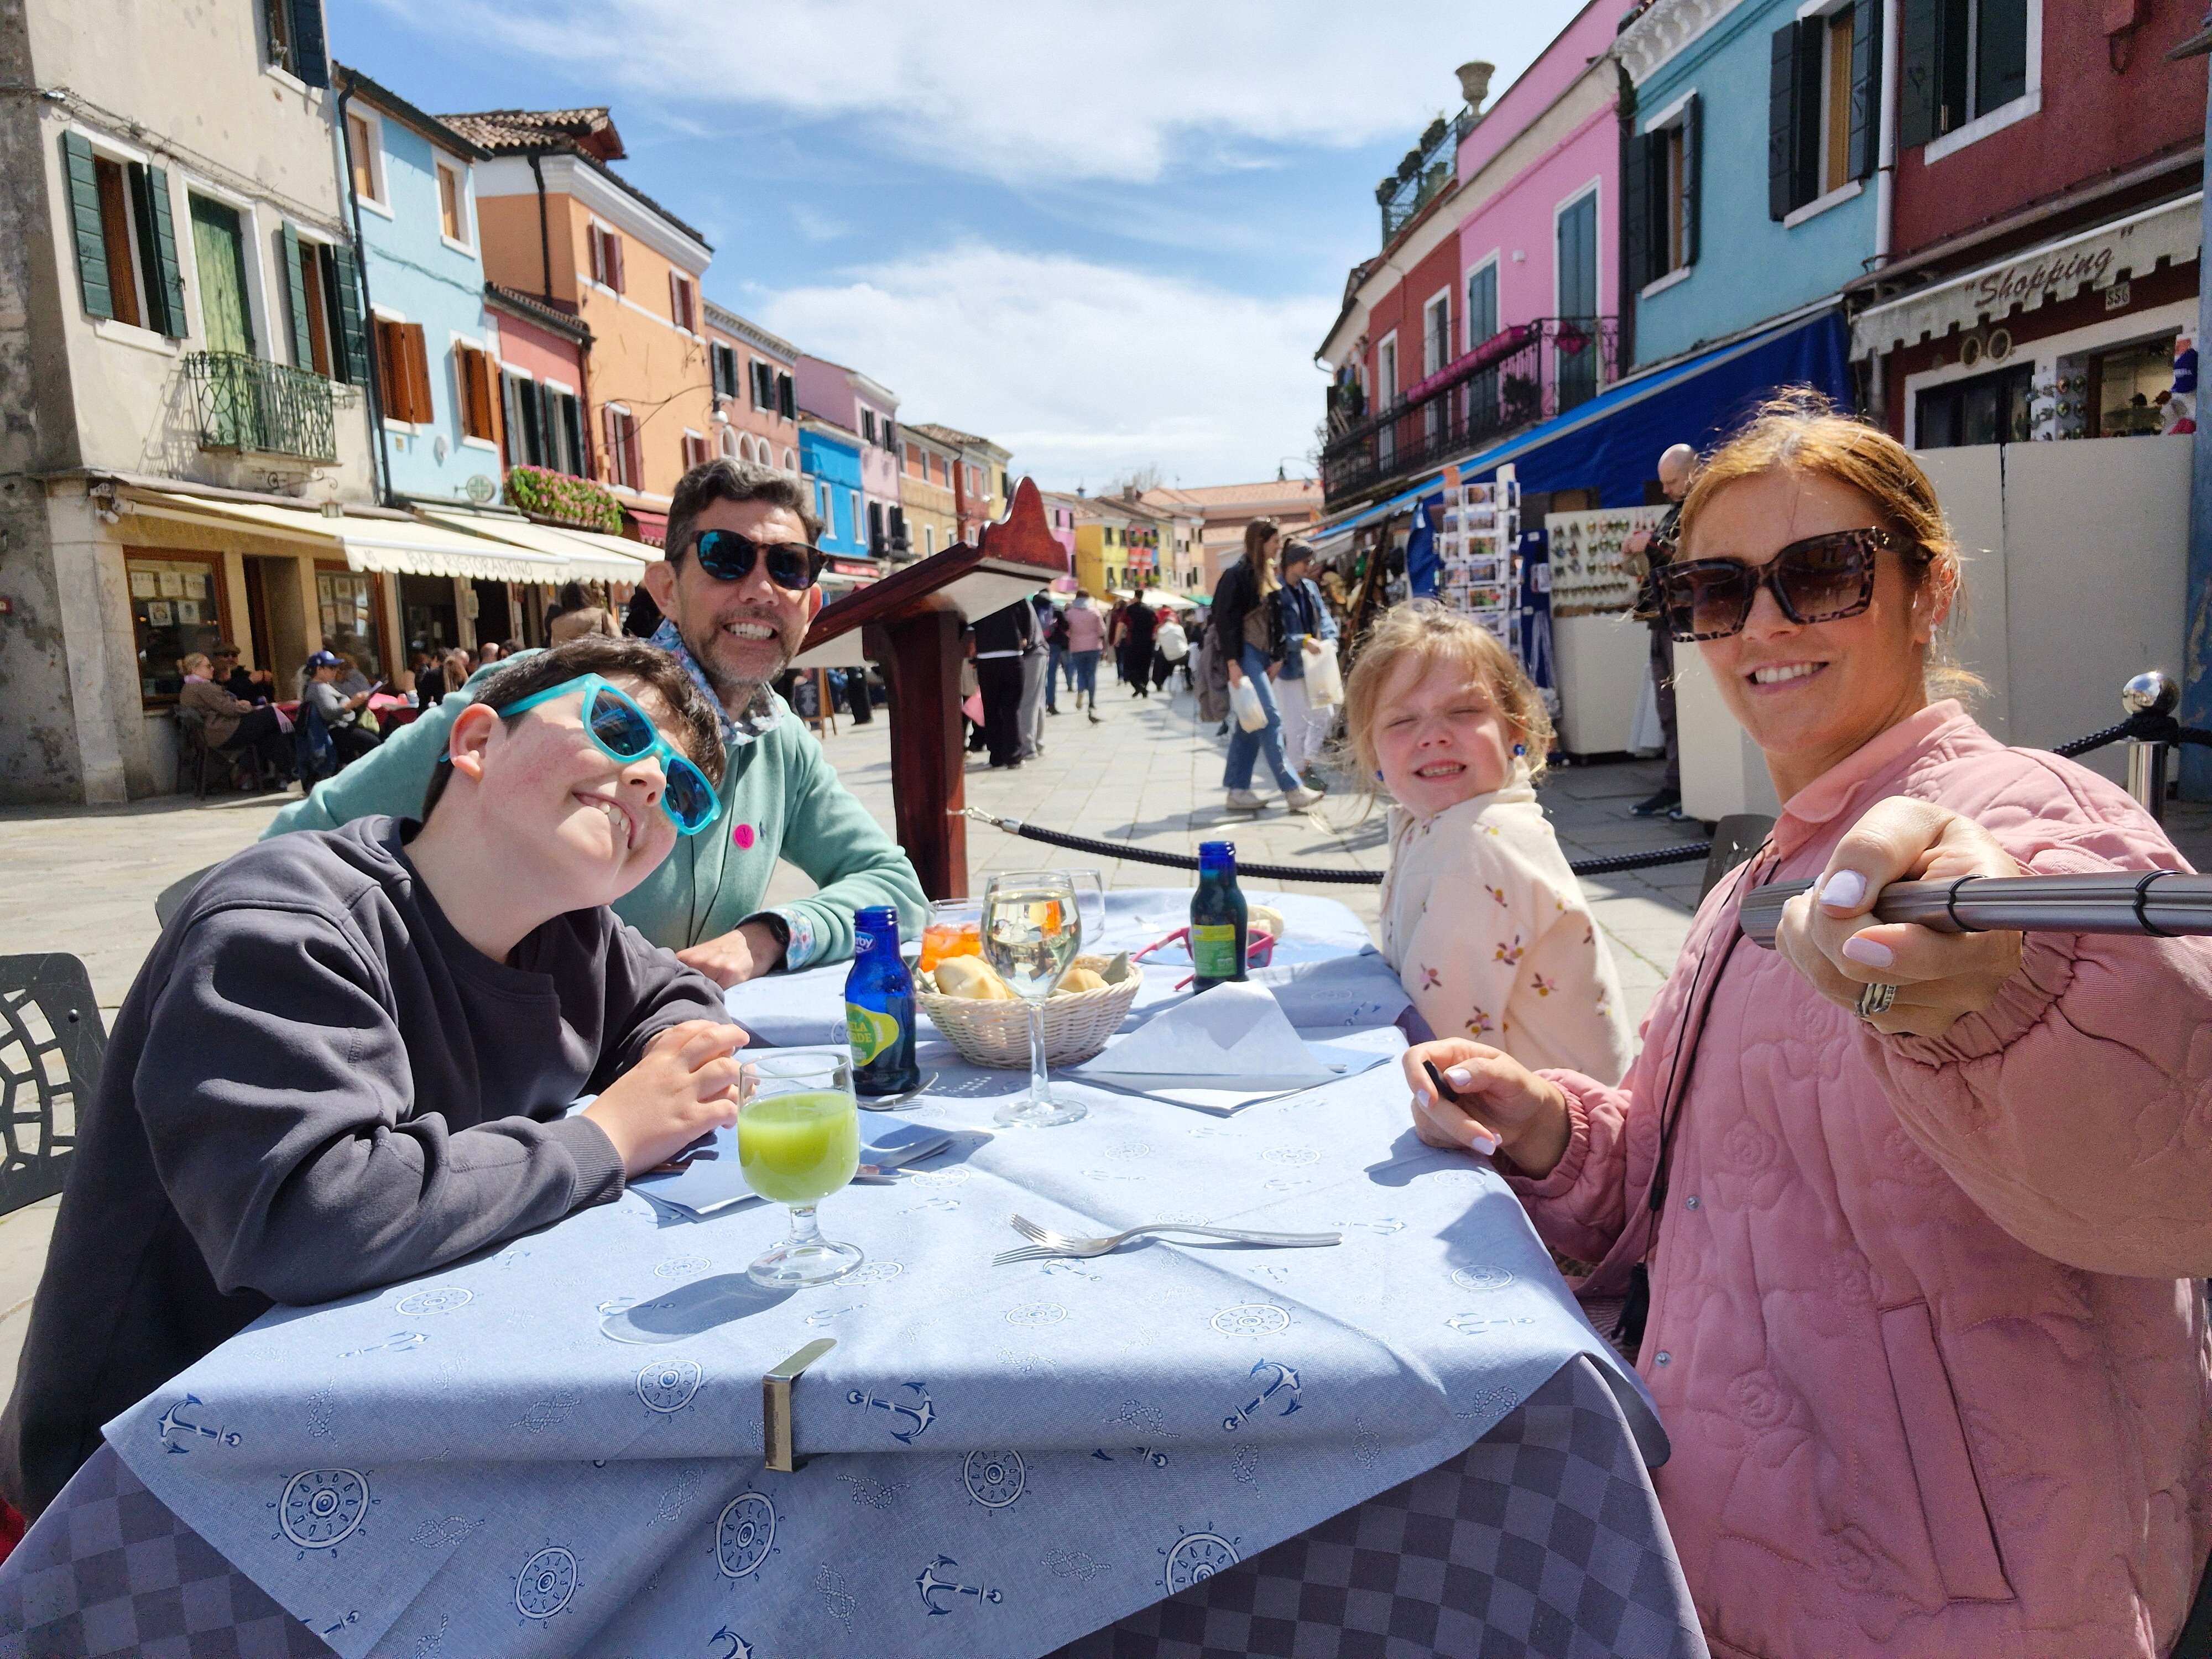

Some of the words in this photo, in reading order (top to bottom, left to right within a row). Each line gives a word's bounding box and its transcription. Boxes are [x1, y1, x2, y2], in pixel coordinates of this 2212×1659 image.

[406, 551, 441, 567] BAR
[442, 552, 532, 576] RISTORANTINO
[855, 936, 874, 948] rby
[848, 1021, 868, 1032] ELA
